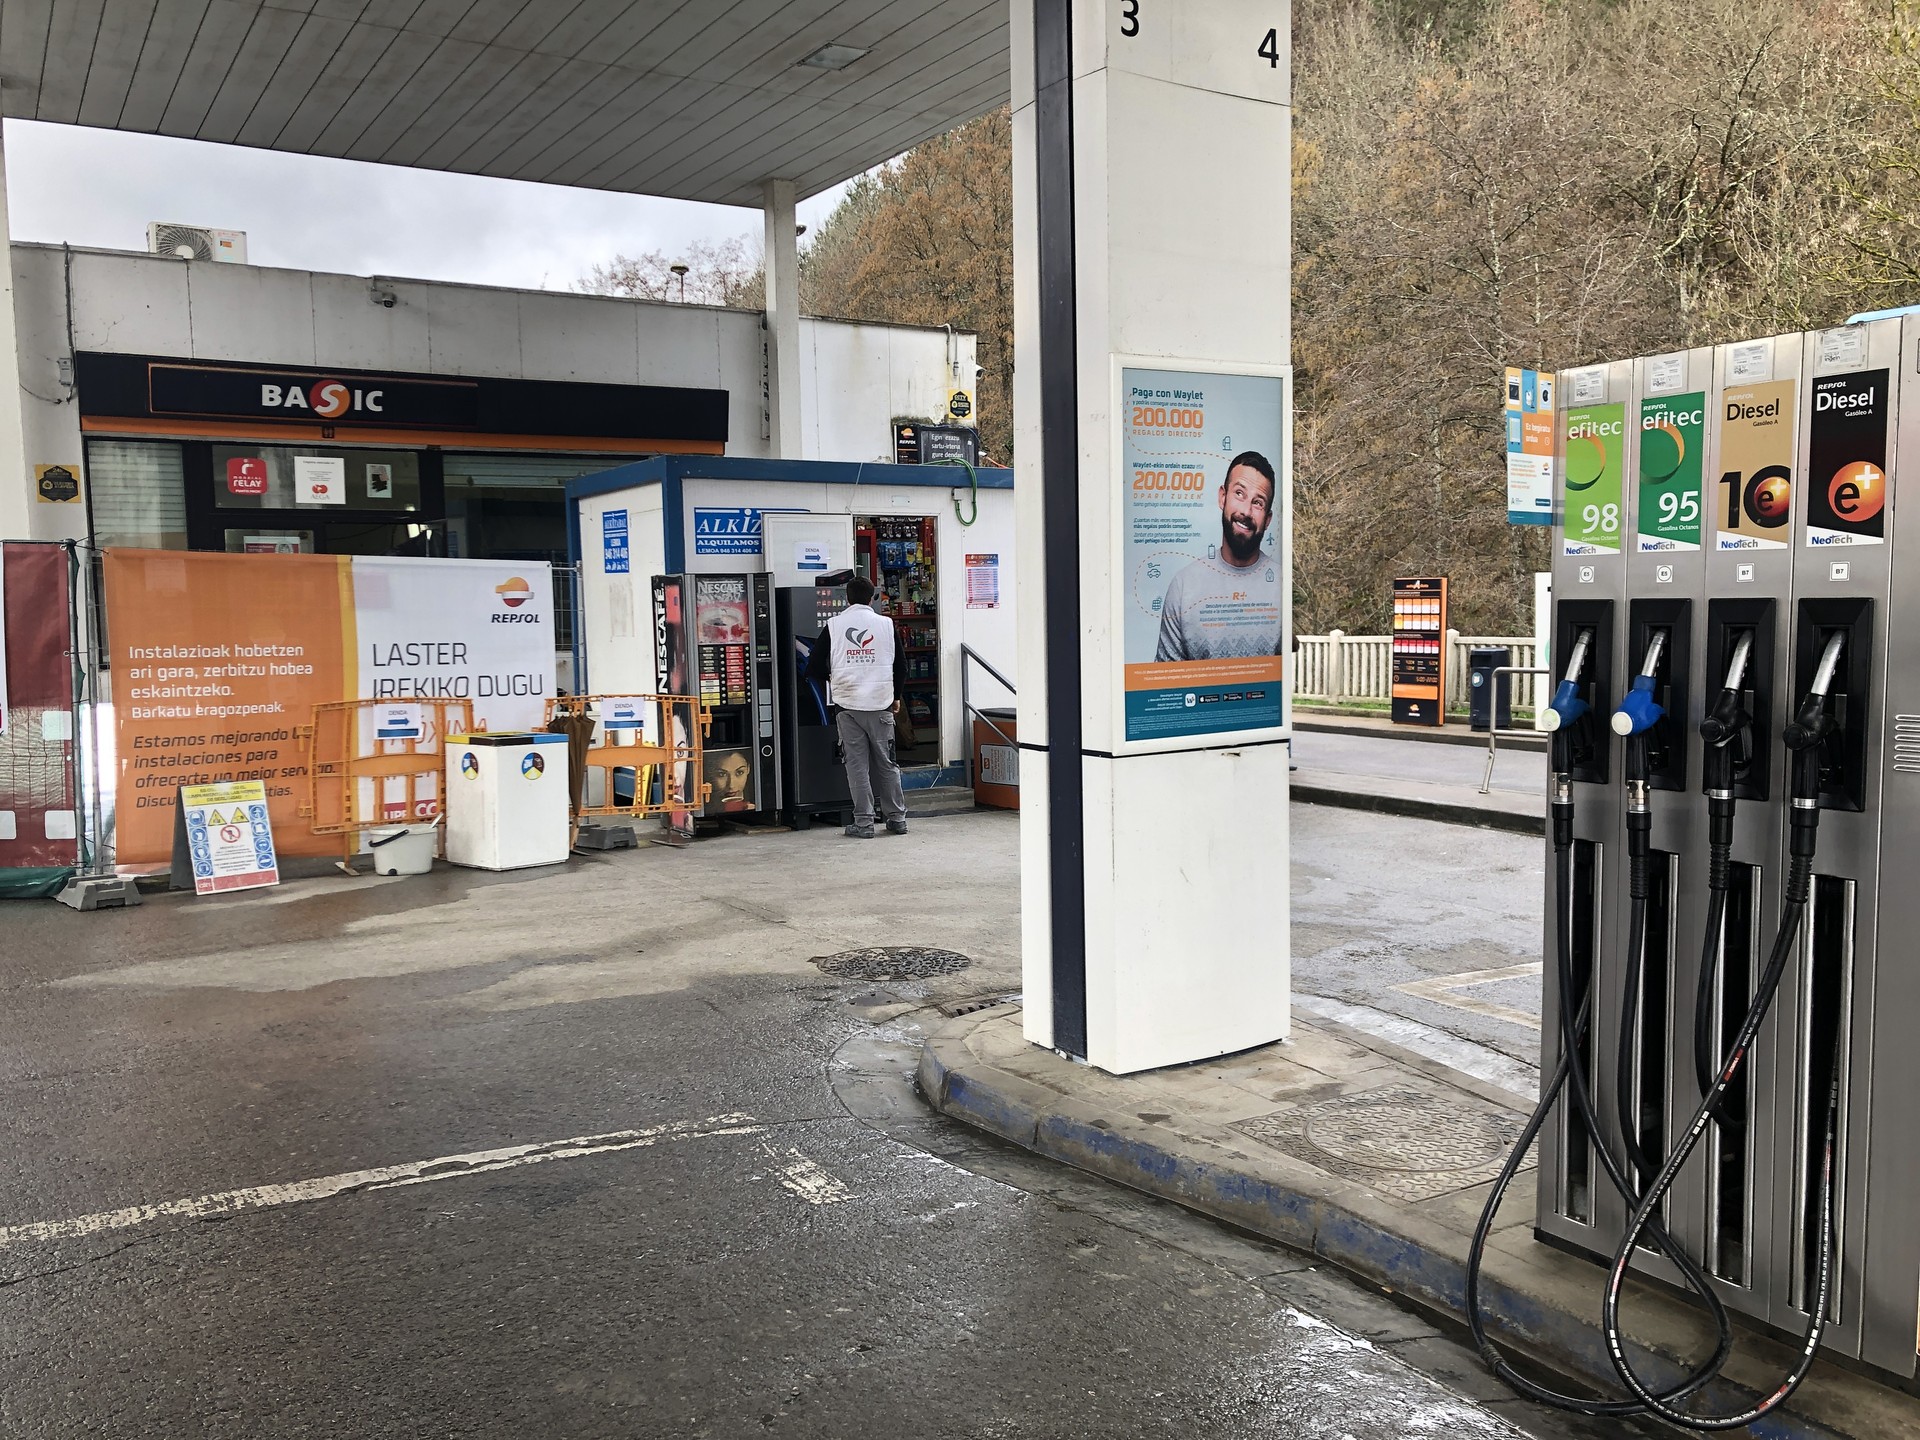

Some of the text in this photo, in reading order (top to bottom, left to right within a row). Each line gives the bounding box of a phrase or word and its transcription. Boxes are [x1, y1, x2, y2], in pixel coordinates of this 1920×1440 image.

[1120, 0, 1140, 37] 3
[1258, 28, 1279, 68] 4
[1132, 388, 1153, 399] Paga
[1174, 390, 1204, 401] Waylet
[1817, 381, 1847, 390] REPSOL
[261, 384, 384, 412] BASIC
[1816, 386, 1874, 412] Diesel
[1132, 406, 1204, 428] 200.000
[1726, 398, 1780, 421] Diesel
[1568, 421, 1622, 439] efitec
[1642, 410, 1702, 430] efitec
[1133, 470, 1205, 491] 200.000
[1834, 464, 1880, 514] e+
[1720, 464, 1790, 528] 10
[1658, 491, 1699, 523] 95
[1582, 503, 1618, 534] 98
[1642, 542, 1676, 550] NeoTech
[1721, 539, 1758, 549] NeoTech
[1811, 534, 1853, 544] NeoTech
[1566, 546, 1596, 555] NeoTech
[698, 580, 744, 594] NESCAFÉ
[491, 614, 540, 623] REPSOL
[129, 644, 304, 658] Instalazioak hobetzen
[373, 642, 468, 666] LASTER
[130, 662, 313, 682] ari gara, zerbitzu hobea
[131, 683, 235, 698] eskaintzeko.
[373, 674, 543, 698] IREKIKO DUGU
[132, 701, 285, 718] Barkatu eragozpenak.
[134, 734, 205, 748] Estamos
[210, 728, 288, 746] mejorando
[134, 749, 278, 768] instalaciones para
[136, 772, 208, 788] ofrecerte
